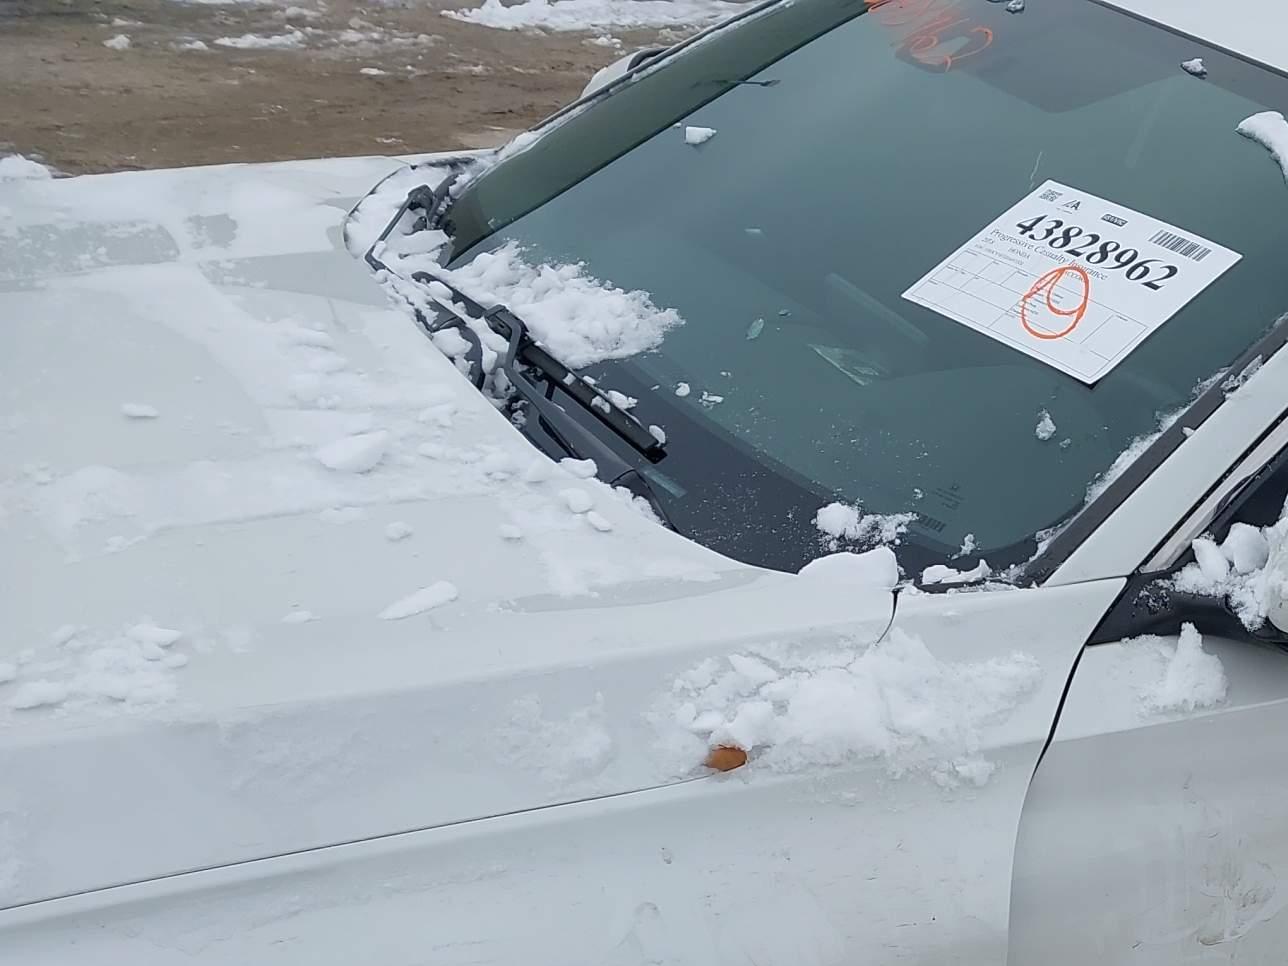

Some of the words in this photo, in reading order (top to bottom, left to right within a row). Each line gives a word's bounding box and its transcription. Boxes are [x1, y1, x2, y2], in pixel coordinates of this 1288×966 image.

[990, 228, 1034, 250] Progressive
[1034, 245, 1067, 265] Casualty
[1068, 260, 1109, 281] Insurance
[1016, 214, 1178, 291] 43828962
